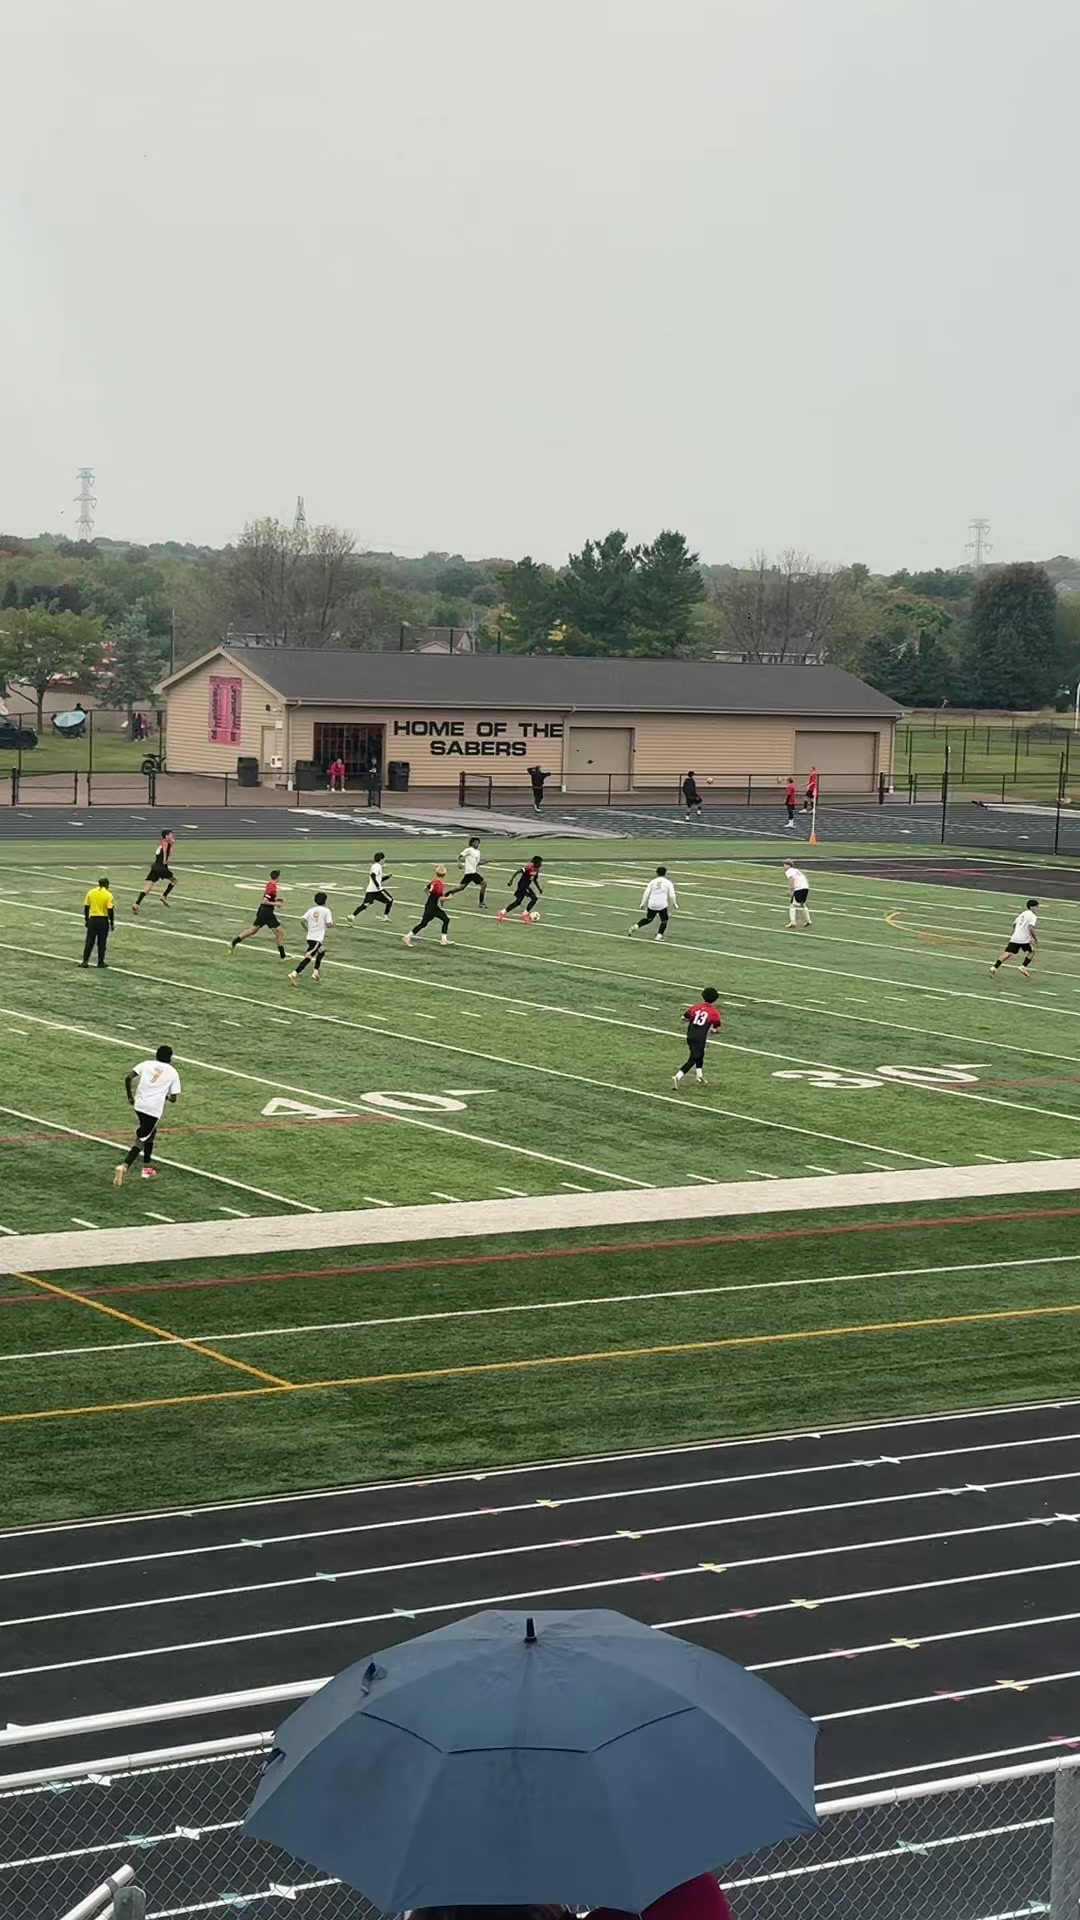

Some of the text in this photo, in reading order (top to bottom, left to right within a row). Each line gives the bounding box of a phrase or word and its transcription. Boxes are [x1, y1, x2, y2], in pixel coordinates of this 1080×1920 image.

[394, 720, 563, 738] HOME OF THE
[430, 740, 527, 756] SABERS
[693, 1009, 709, 1026] 13
[150, 1066, 164, 1083] 7
[772, 1065, 979, 1089] 30
[261, 1091, 467, 1120] 40
